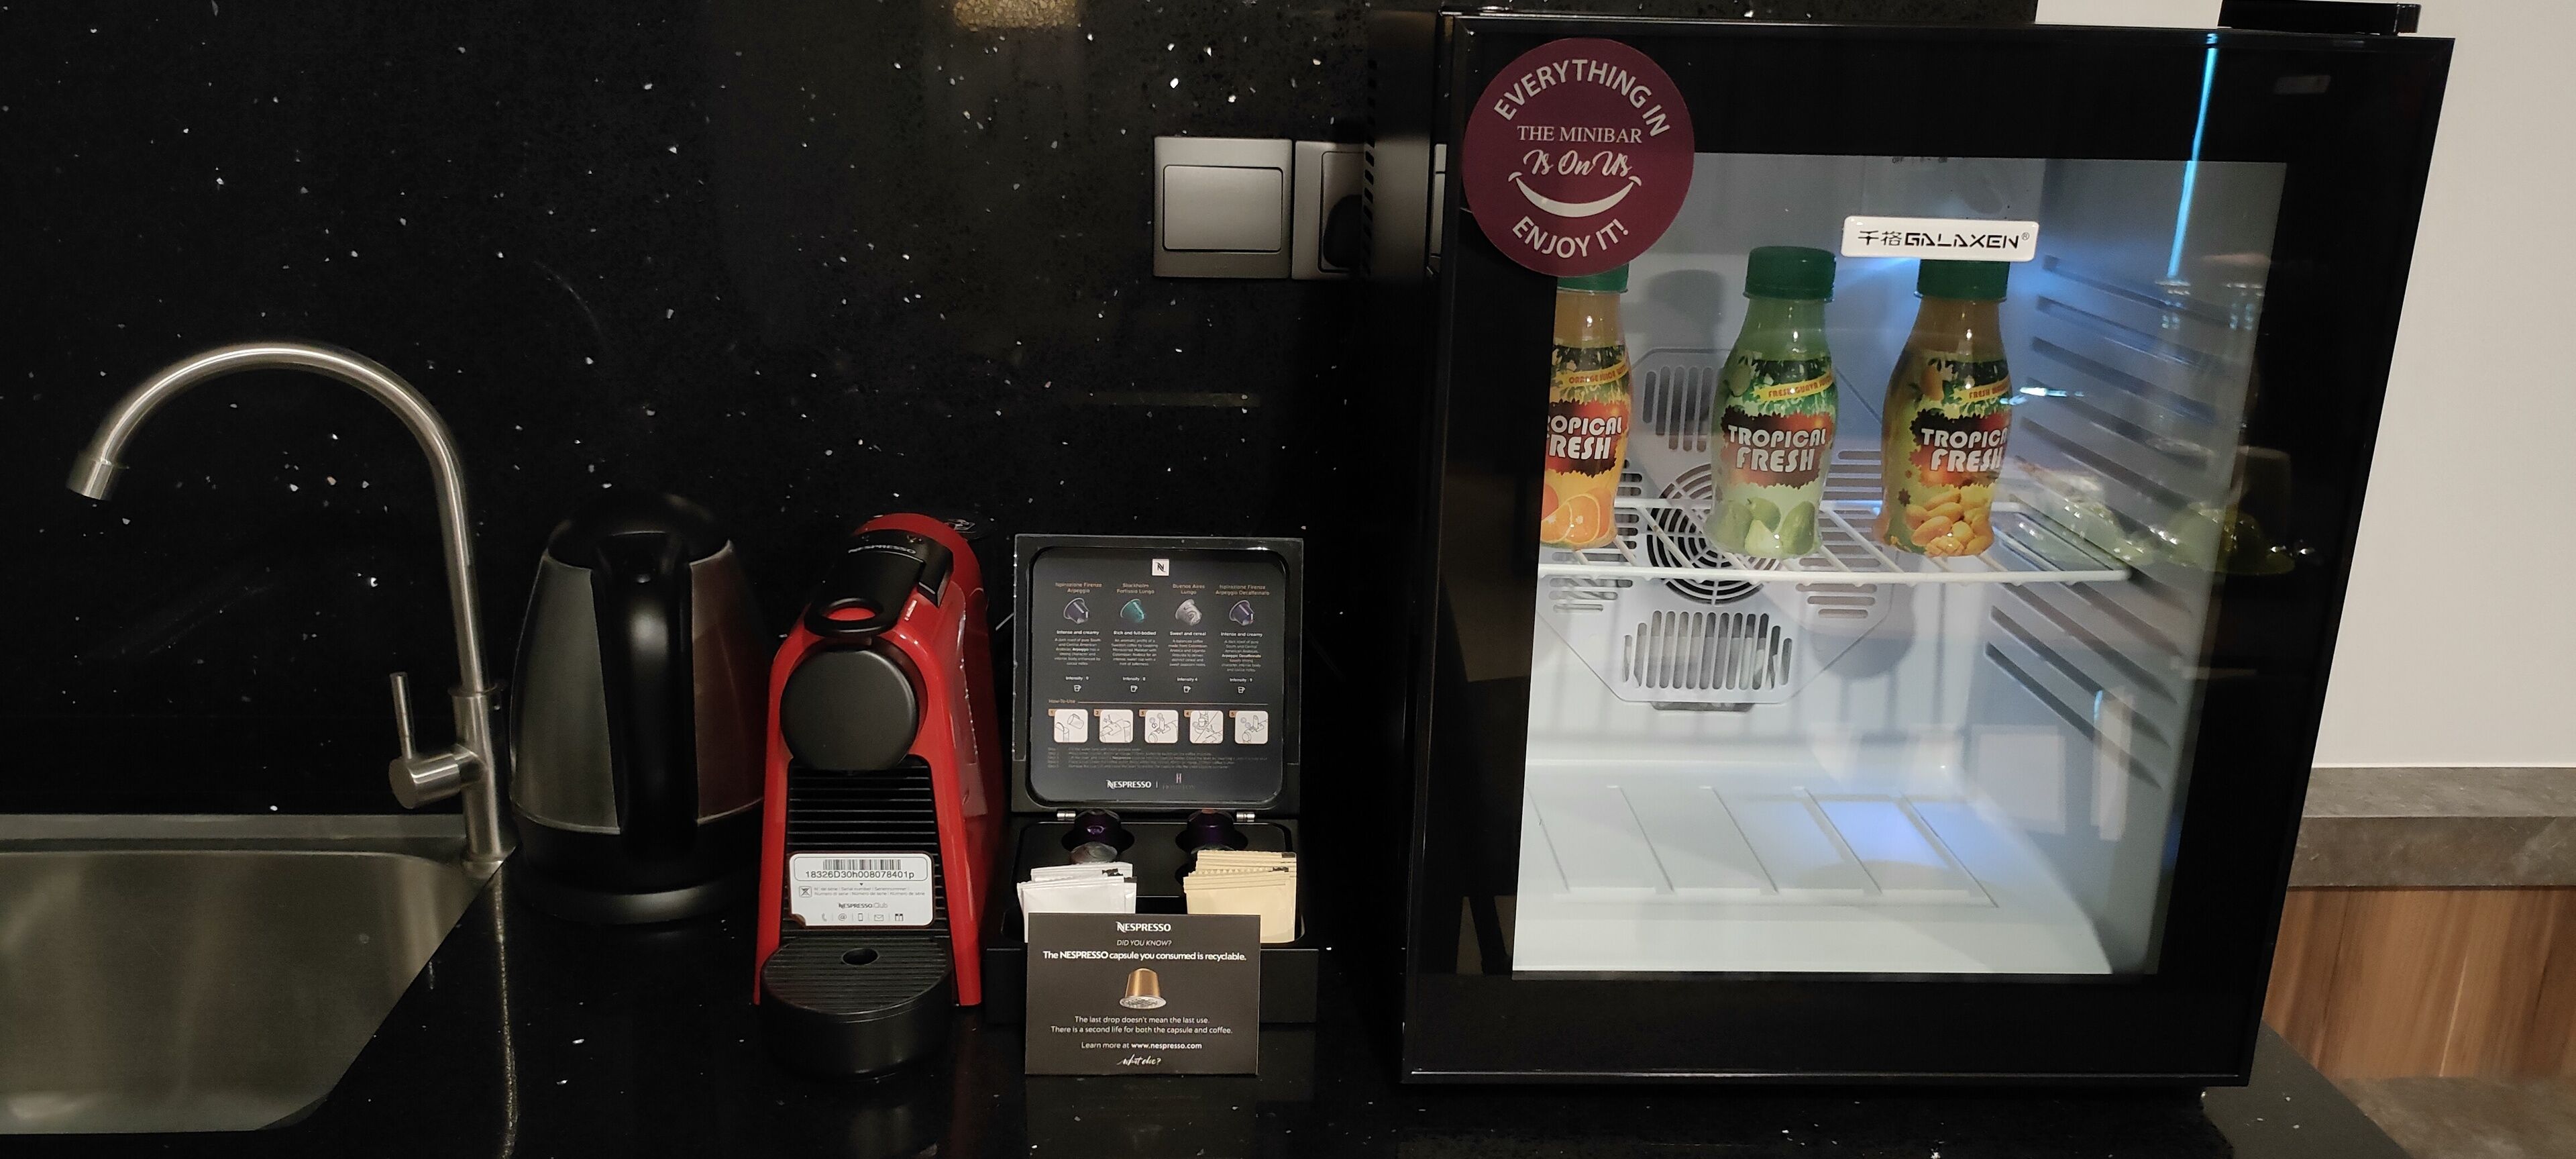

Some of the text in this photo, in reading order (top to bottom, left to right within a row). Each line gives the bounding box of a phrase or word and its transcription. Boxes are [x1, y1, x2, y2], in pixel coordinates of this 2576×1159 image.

[1494, 59, 1670, 137] EVERYTHING IN
[1517, 125, 1642, 143] THE MINIBAR
[1523, 150, 1632, 177] Is On Us
[1512, 215, 1628, 258] ENJOY IT!
[1569, 375, 1598, 384] ORAGE
[1547, 415, 1622, 436] OPICAL
[1728, 424, 1826, 448] TROPICAL
[1547, 434, 1611, 460] RESH
[1921, 427, 2008, 448] TROPICA
[1736, 446, 1815, 472] FRESH
[1930, 446, 2003, 472] FRESH
[1106, 779, 1152, 789] NESPRESSO
[1116, 921, 1171, 933] NESPRESSO
[1043, 951, 1059, 959] The
[1060, 951, 1108, 959] NESPRESSO
[1109, 952, 1139, 961] capsule
[1205, 952, 1246, 962] recyclable.
